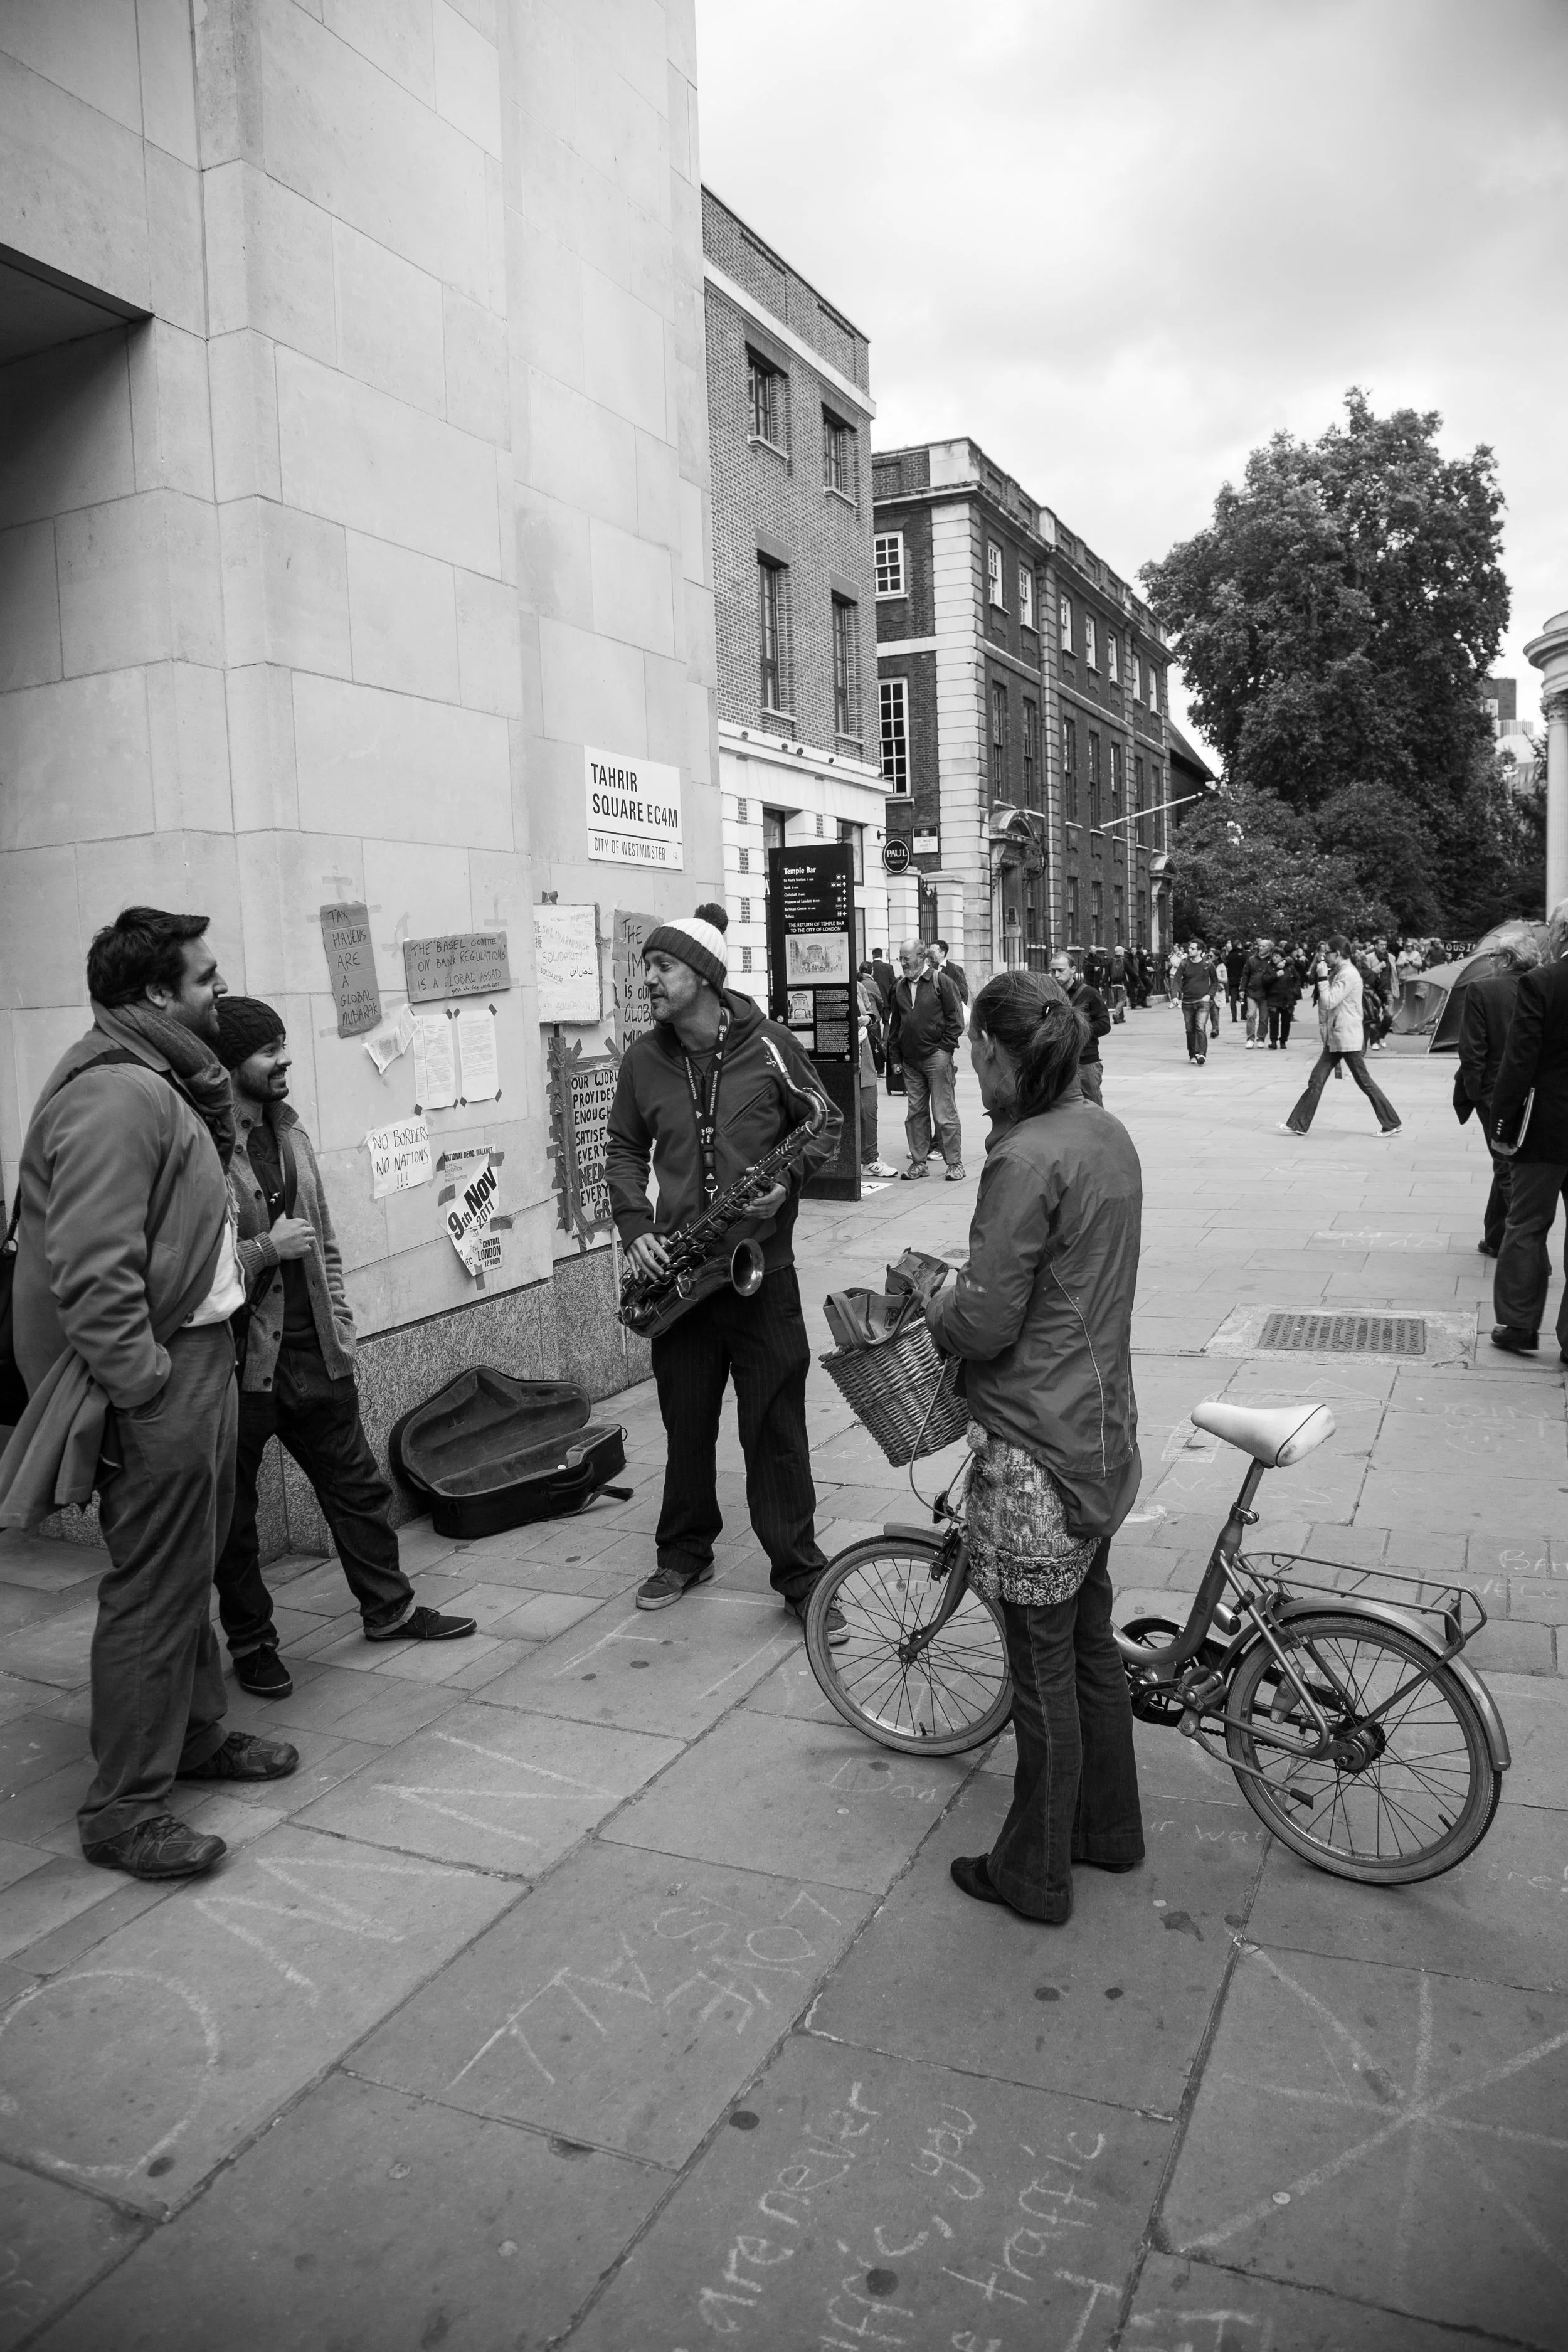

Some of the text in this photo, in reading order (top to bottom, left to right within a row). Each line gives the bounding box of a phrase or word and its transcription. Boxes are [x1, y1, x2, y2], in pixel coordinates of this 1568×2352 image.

[591, 763, 637, 792] TAHRIR
[593, 793, 678, 829] SQUARE EC4M
[594, 837, 666, 861] CITY OF WESTMINSTER
[886, 849, 908, 857] PAUL
[783, 867, 805, 875] Temple
[327, 909, 348, 924] TAX
[332, 928, 366, 949] HAVENS
[622, 918, 643, 945] THE
[410, 941, 432, 956] THE
[541, 951, 583, 965] SOLIDARITY
[1443, 943, 1476, 952] OUSI
[337, 951, 361, 972] ARE
[418, 959, 430, 972] ON
[437, 954, 456, 969] BANK
[627, 951, 647, 978] IM
[342, 975, 349, 988] A
[417, 968, 502, 992] IS A GLOBAL ASSAD
[340, 989, 374, 1007] GLOBAL
[342, 1004, 378, 1026] MUBARAK
[624, 1003, 657, 1027] GLOBA
[571, 1069, 618, 1091] OUR WORL
[573, 1086, 615, 1110] PROVIDES
[373, 1125, 429, 1150] NO BORDERS
[576, 1126, 606, 1147] SATISF
[376, 1147, 429, 1177] NO NATIONS
[443, 1152, 464, 1162] NATIONAL
[464, 1149, 476, 1158] DEMO.
[578, 1142, 608, 1166] EVERY
[578, 1162, 605, 1189] NEED
[581, 1184, 610, 1207] EVERY
[476, 1199, 495, 1230] 2011
[593, 1199, 612, 1219] GR
[448, 1210, 473, 1241] 9th
[477, 1244, 501, 1261] LONDON
[482, 1237, 501, 1248] CENTRAL
[1340, 1237, 1443, 1249] DEAD
[484, 1257, 501, 1268] 12 NOON
[1157, 1476, 1343, 1504] NESS
[697, 2081, 881, 2333] are never
[942, 2131, 1106, 2304] traffic
[819, 2101, 986, 2352] ffic, you
